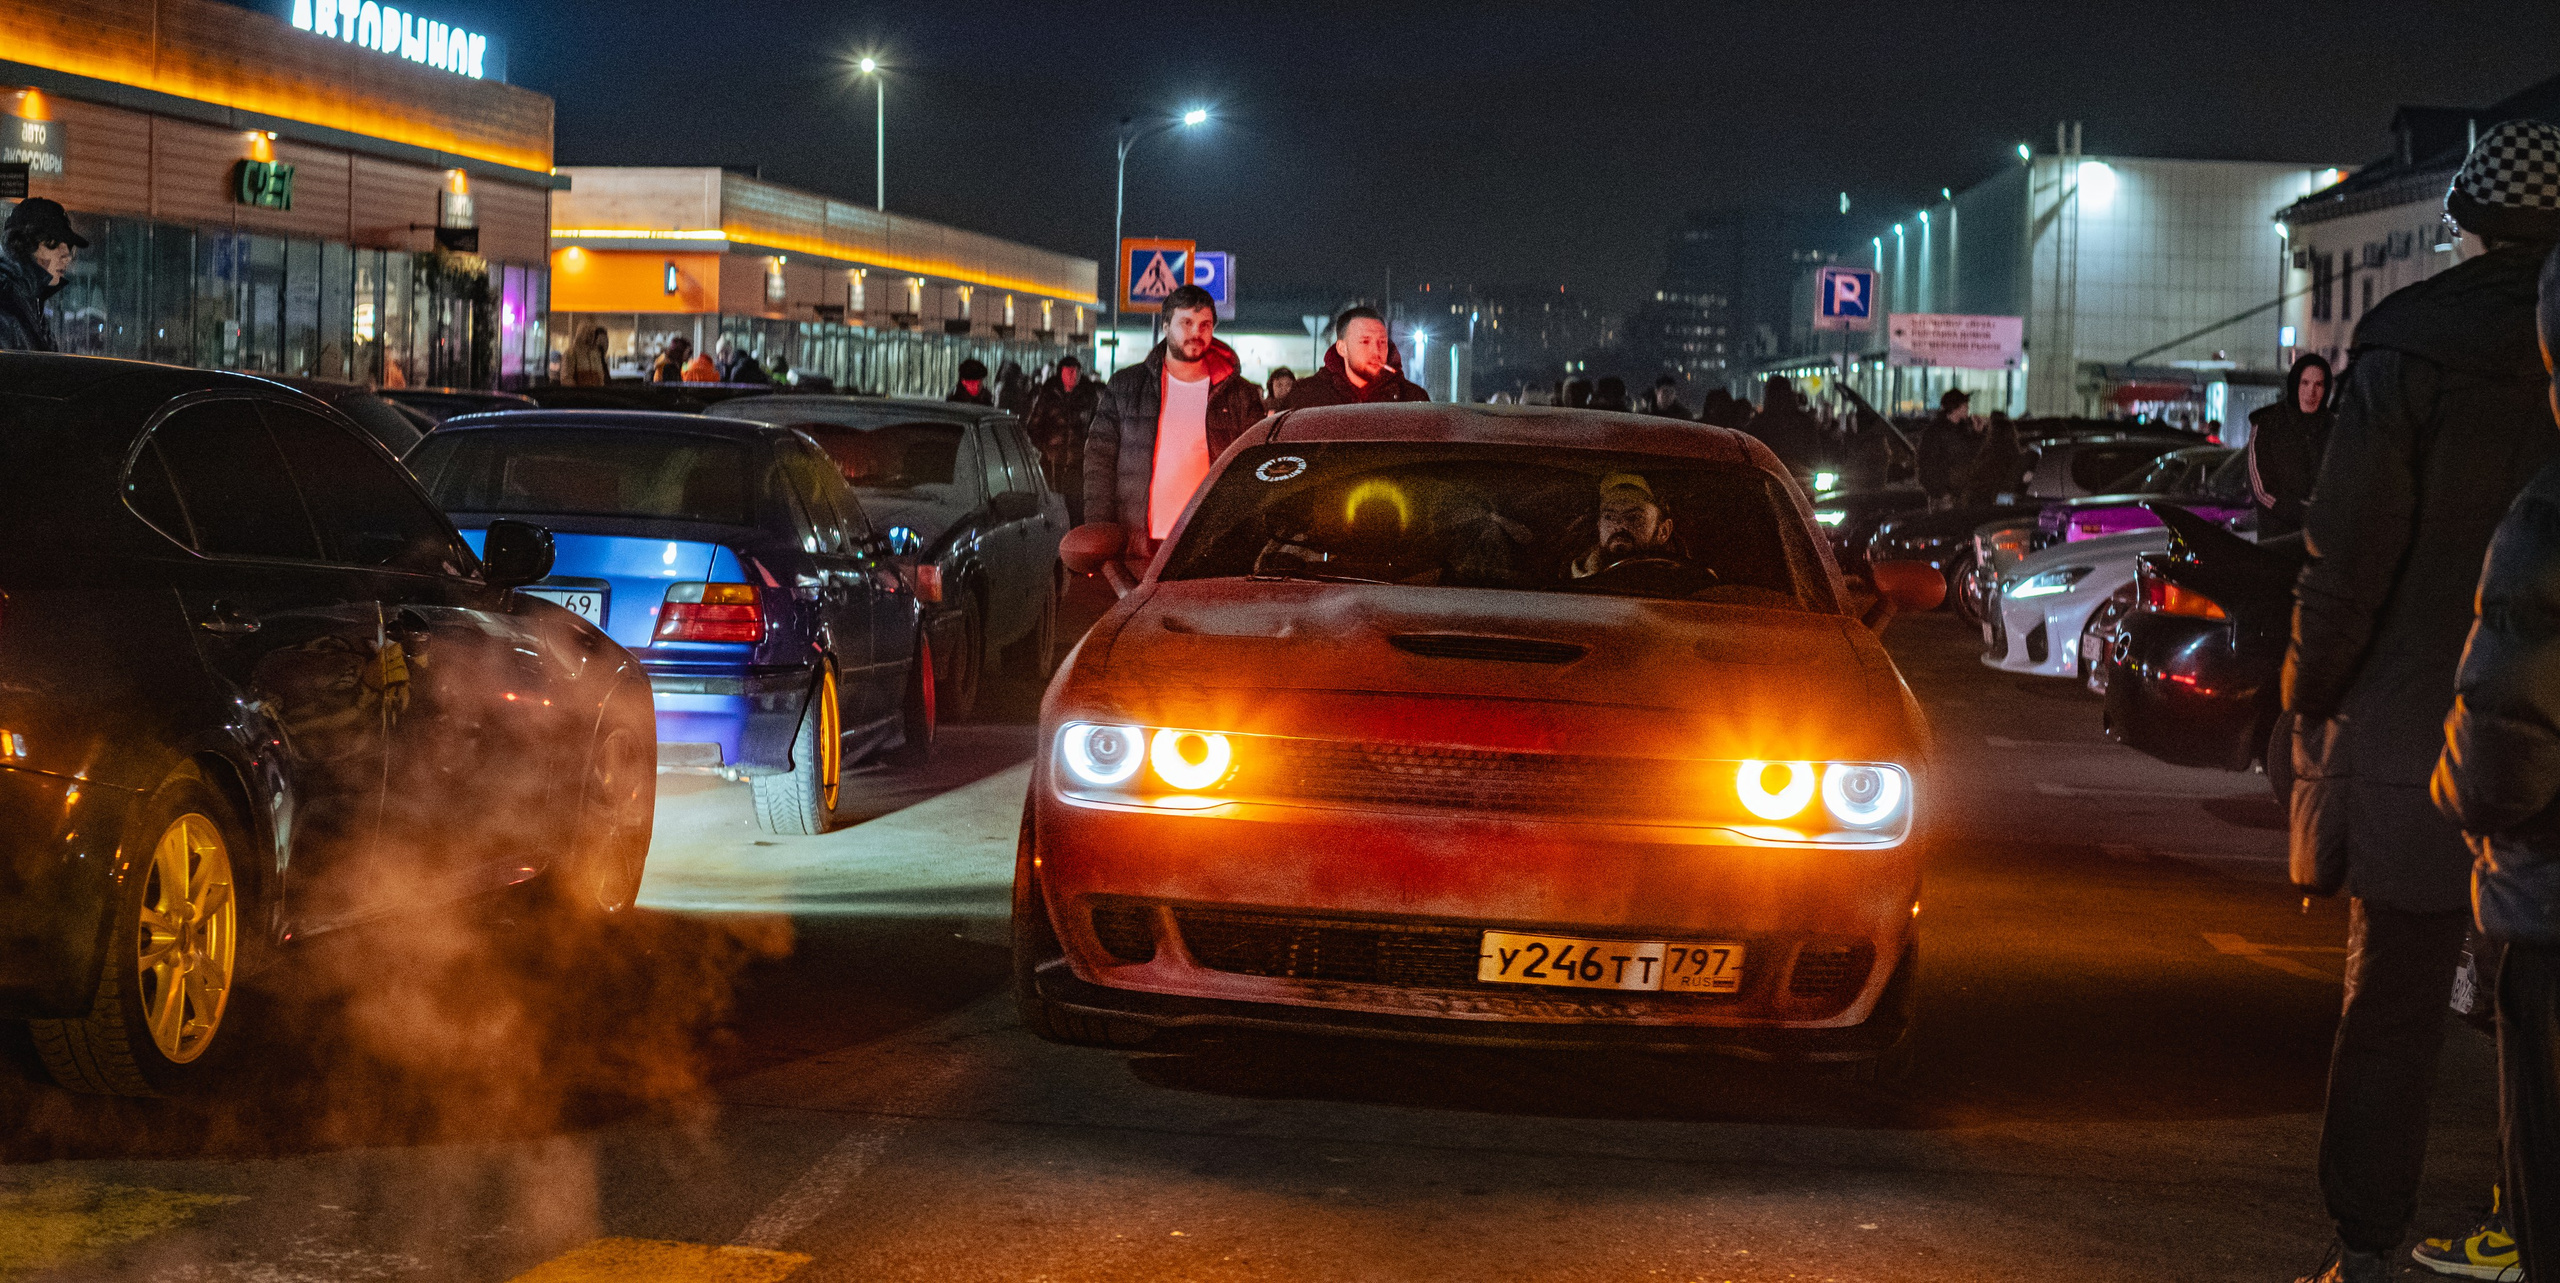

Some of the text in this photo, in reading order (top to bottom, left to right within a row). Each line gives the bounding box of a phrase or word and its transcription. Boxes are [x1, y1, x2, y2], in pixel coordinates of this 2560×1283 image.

[564, 595, 592, 615] 69
[1670, 947, 1731, 976] 797
[1681, 976, 1711, 987] RUS
